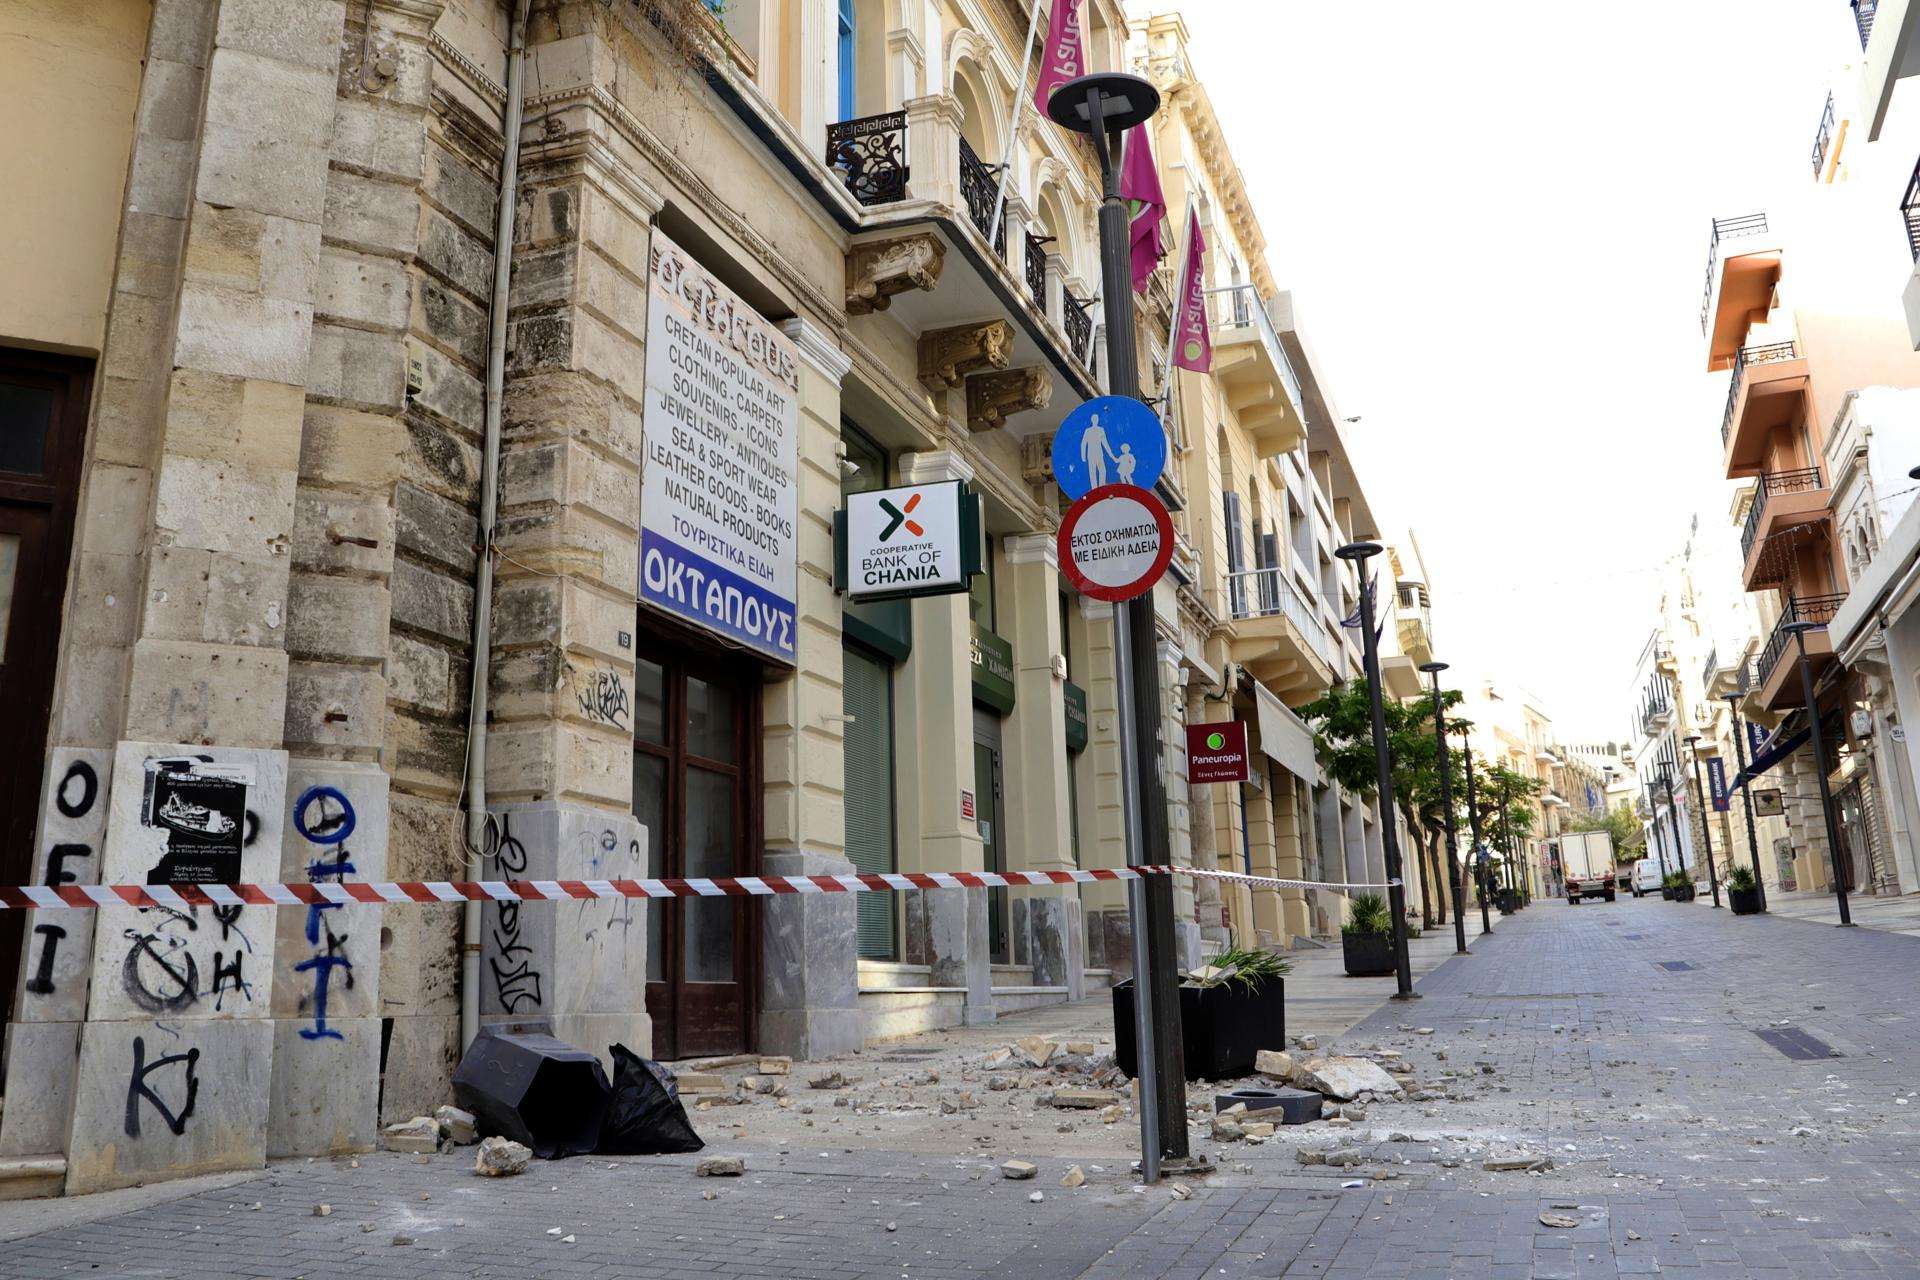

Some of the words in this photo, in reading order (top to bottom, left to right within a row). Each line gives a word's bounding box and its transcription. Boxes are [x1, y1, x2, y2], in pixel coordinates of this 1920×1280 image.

[665, 314, 711, 362] CRETAN
[714, 351, 764, 400] POPULAR
[766, 389, 785, 414] ART
[669, 344, 727, 399] CLOTHING
[736, 393, 783, 437] CARPETS
[660, 393, 728, 449] JEWELLERY
[736, 442, 787, 488] ANTIQUES
[673, 373, 738, 431] SOUVENIRS
[746, 423, 778, 458] ICONS
[650, 441, 705, 489] LEATHER
[708, 476, 748, 513] GOODS
[756, 502, 792, 540] BOOKS
[672, 426, 695, 457] SEA
[698, 443, 706, 462] &
[709, 450, 745, 485] SPORT
[748, 472, 777, 507] WEAR
[665, 477, 720, 523] NATURAL
[723, 510, 779, 556] PRODUCTS
[672, 514, 745, 568] ΤΟΥΡΙΣΤΙΚΑ
[748, 556, 774, 582] ΕΙΔΗ
[870, 542, 934, 556] COOPERATIVE
[1071, 531, 1102, 548] ΕΚΤΟΣ
[1105, 523, 1159, 543] ΟΧΗΜΑΤΩΝ
[1074, 550, 1089, 563] ΜΕ
[1092, 545, 1125, 561] ΕΙΔΙΚΗ
[1127, 538, 1158, 557] ΑΔΕΙΑ
[862, 555, 907, 571] BANK
[918, 551, 941, 563] OF
[864, 565, 940, 585] CHANIA
[644, 547, 794, 652] ΟΚΤΑΠΟΥΣ
[621, 633, 629, 647] 19
[1192, 753, 1242, 764] Paneuropia
